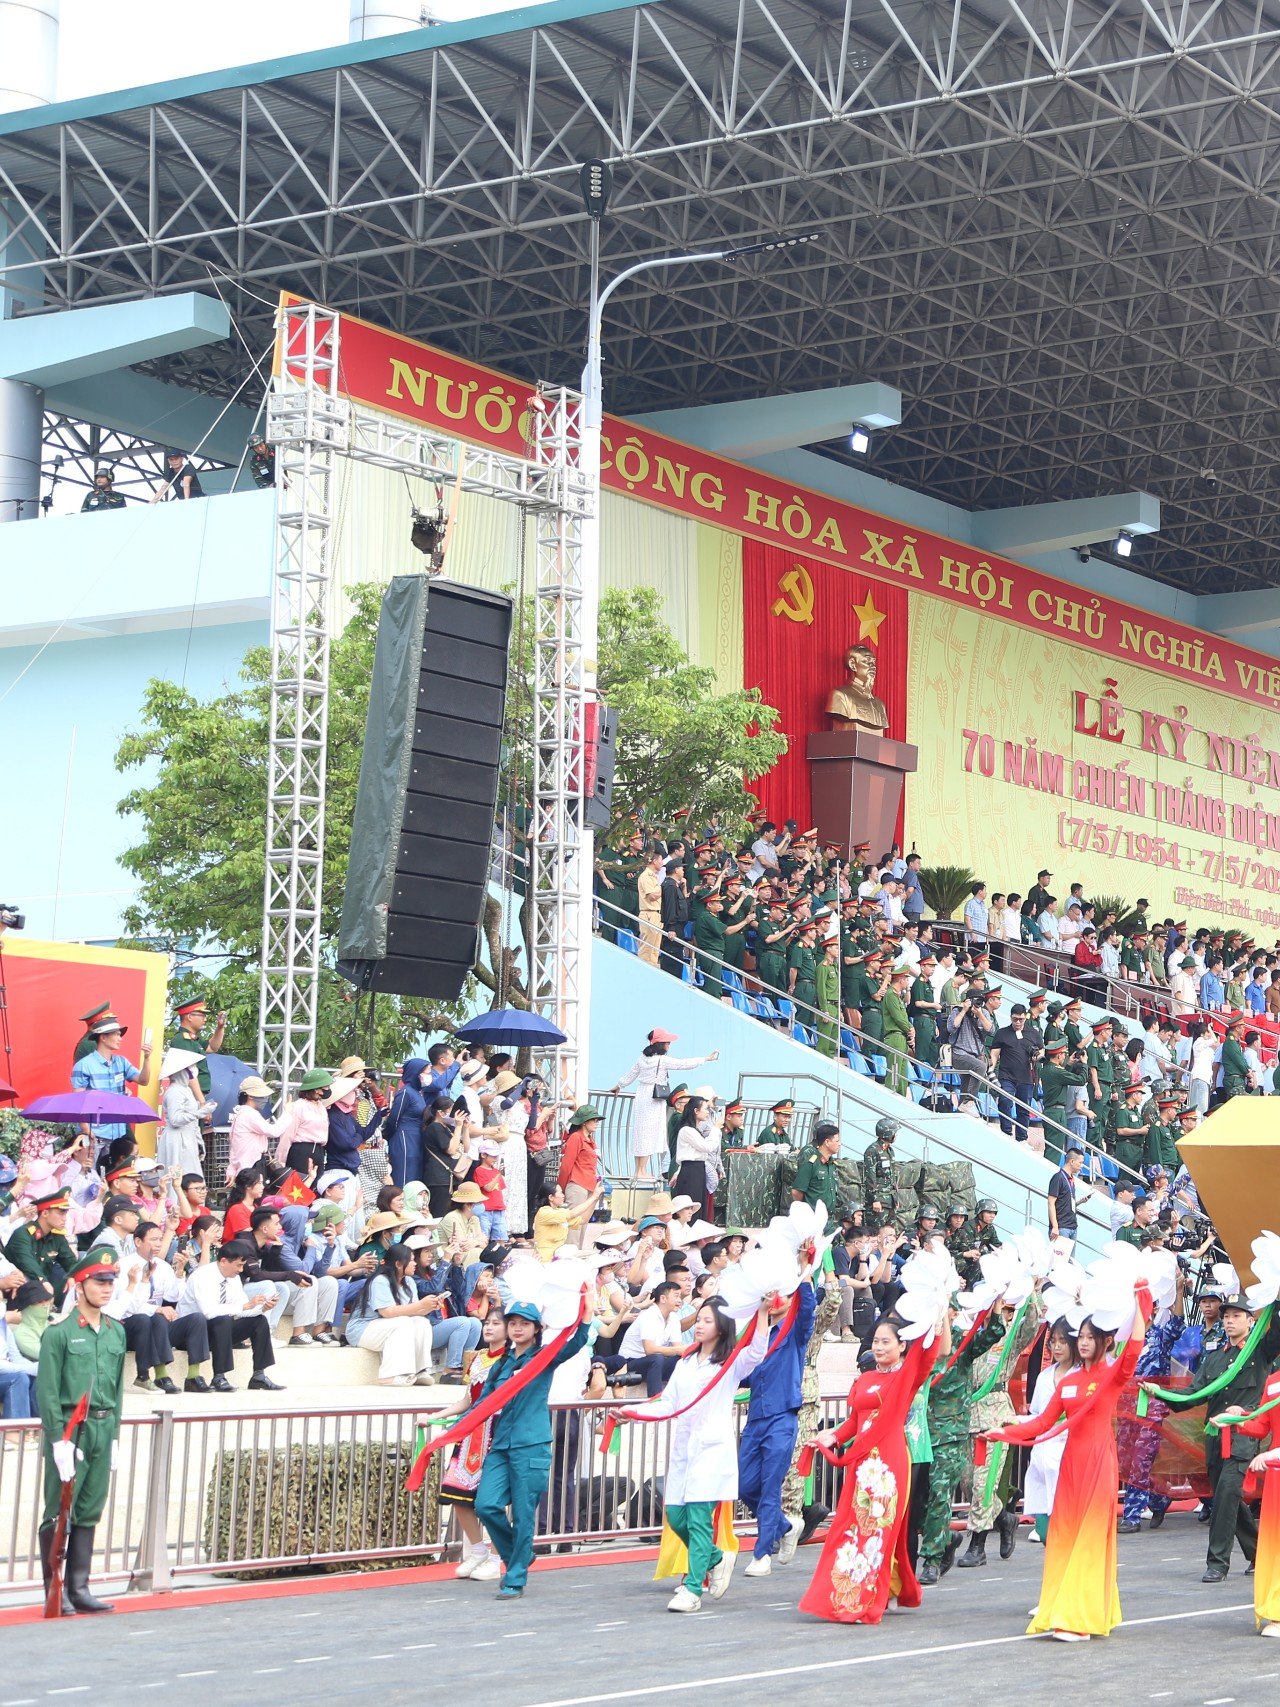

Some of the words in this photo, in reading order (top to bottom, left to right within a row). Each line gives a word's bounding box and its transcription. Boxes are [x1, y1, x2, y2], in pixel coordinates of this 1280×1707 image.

[743, 488, 847, 554] HÒA
[860, 529, 924, 580] XÃ
[938, 556, 1015, 609] HỘI
[1027, 589, 1107, 640] CHỦ
[1118, 619, 1227, 683] NGHĨA
[1074, 677, 1126, 744] LỄ
[1140, 705, 1195, 762] KỶ
[962, 728, 995, 777] 70
[1004, 736, 1064, 796] NĂM
[1073, 759, 1146, 817] CHIẾN
[1152, 776, 1226, 839] THẮNG
[1058, 811, 1181, 870] (7/5/1954
